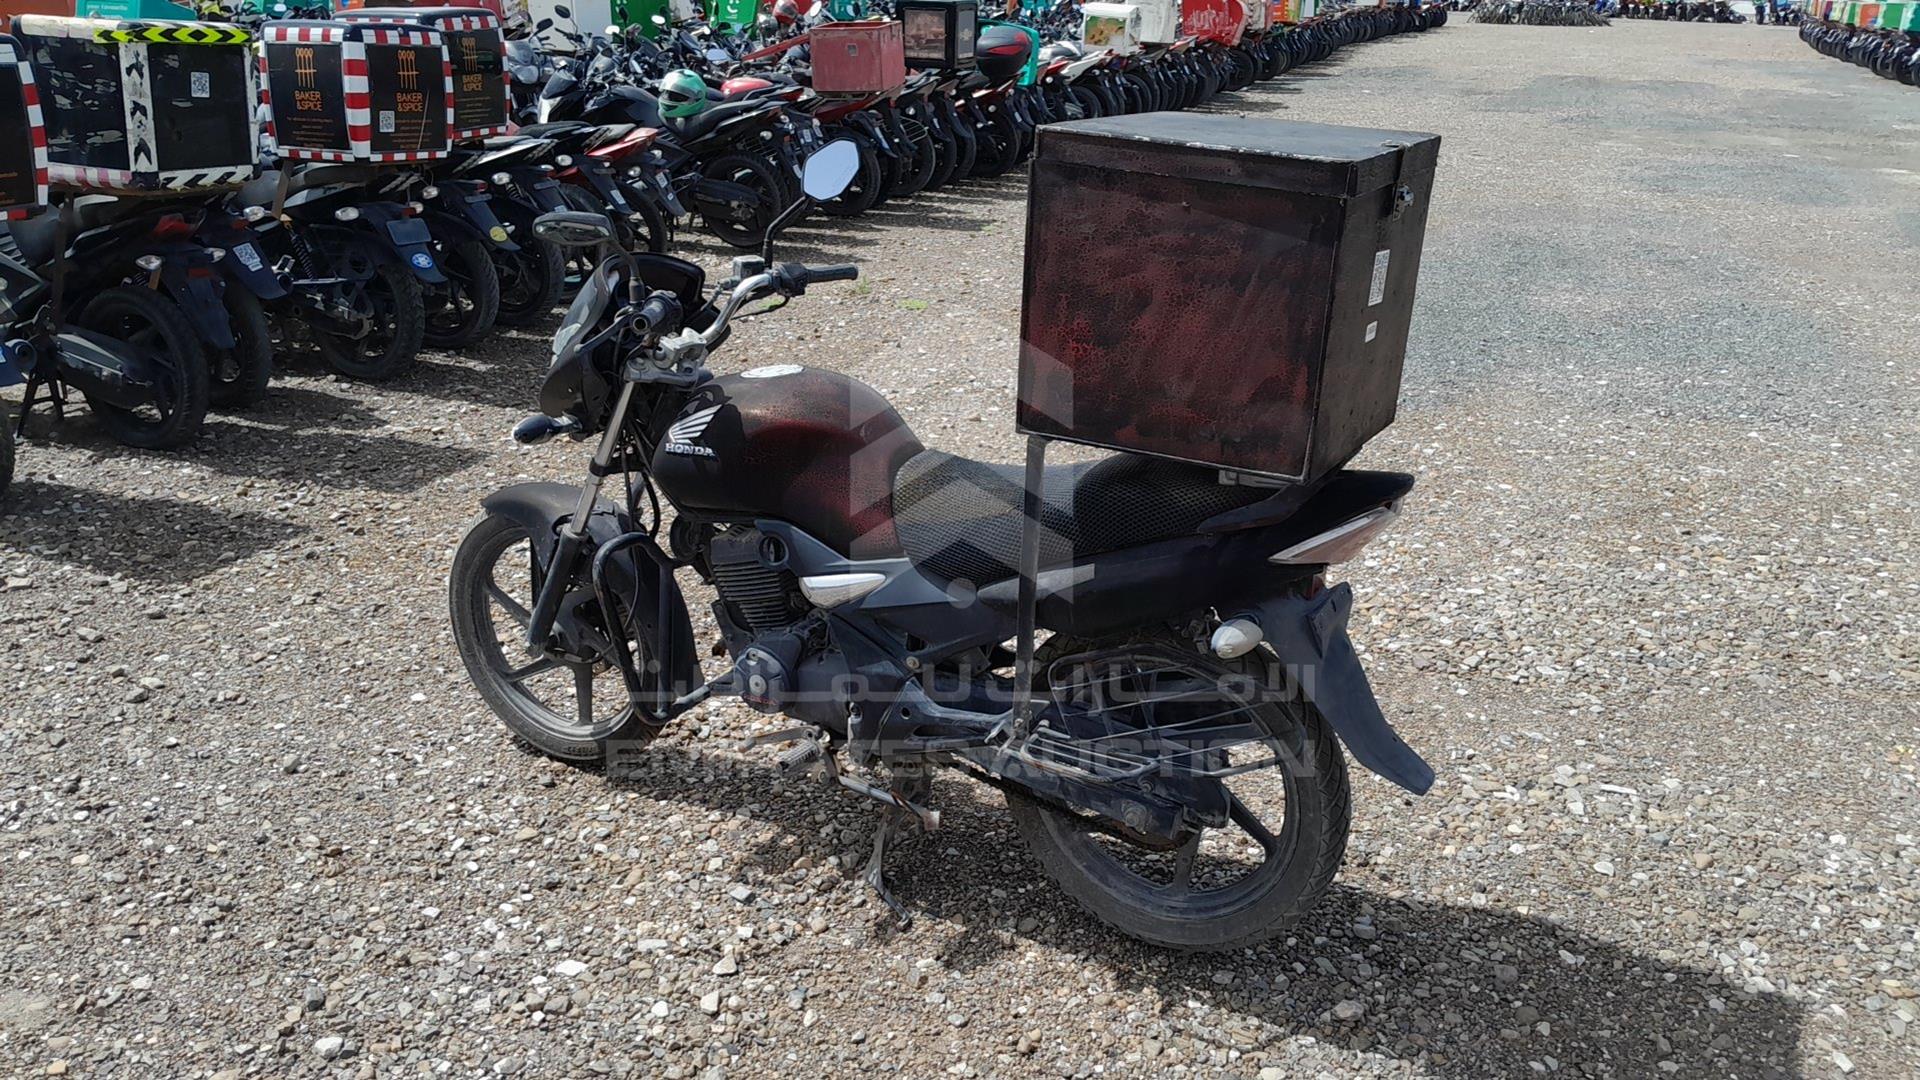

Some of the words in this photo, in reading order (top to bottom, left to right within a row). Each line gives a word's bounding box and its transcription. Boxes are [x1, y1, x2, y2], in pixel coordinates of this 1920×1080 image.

[294, 90, 321, 101] BAKER
[396, 92, 423, 103] BAKER
[296, 100, 323, 112] &SPICE
[397, 102, 424, 113] &SPICE
[665, 442, 716, 457] HONDA
